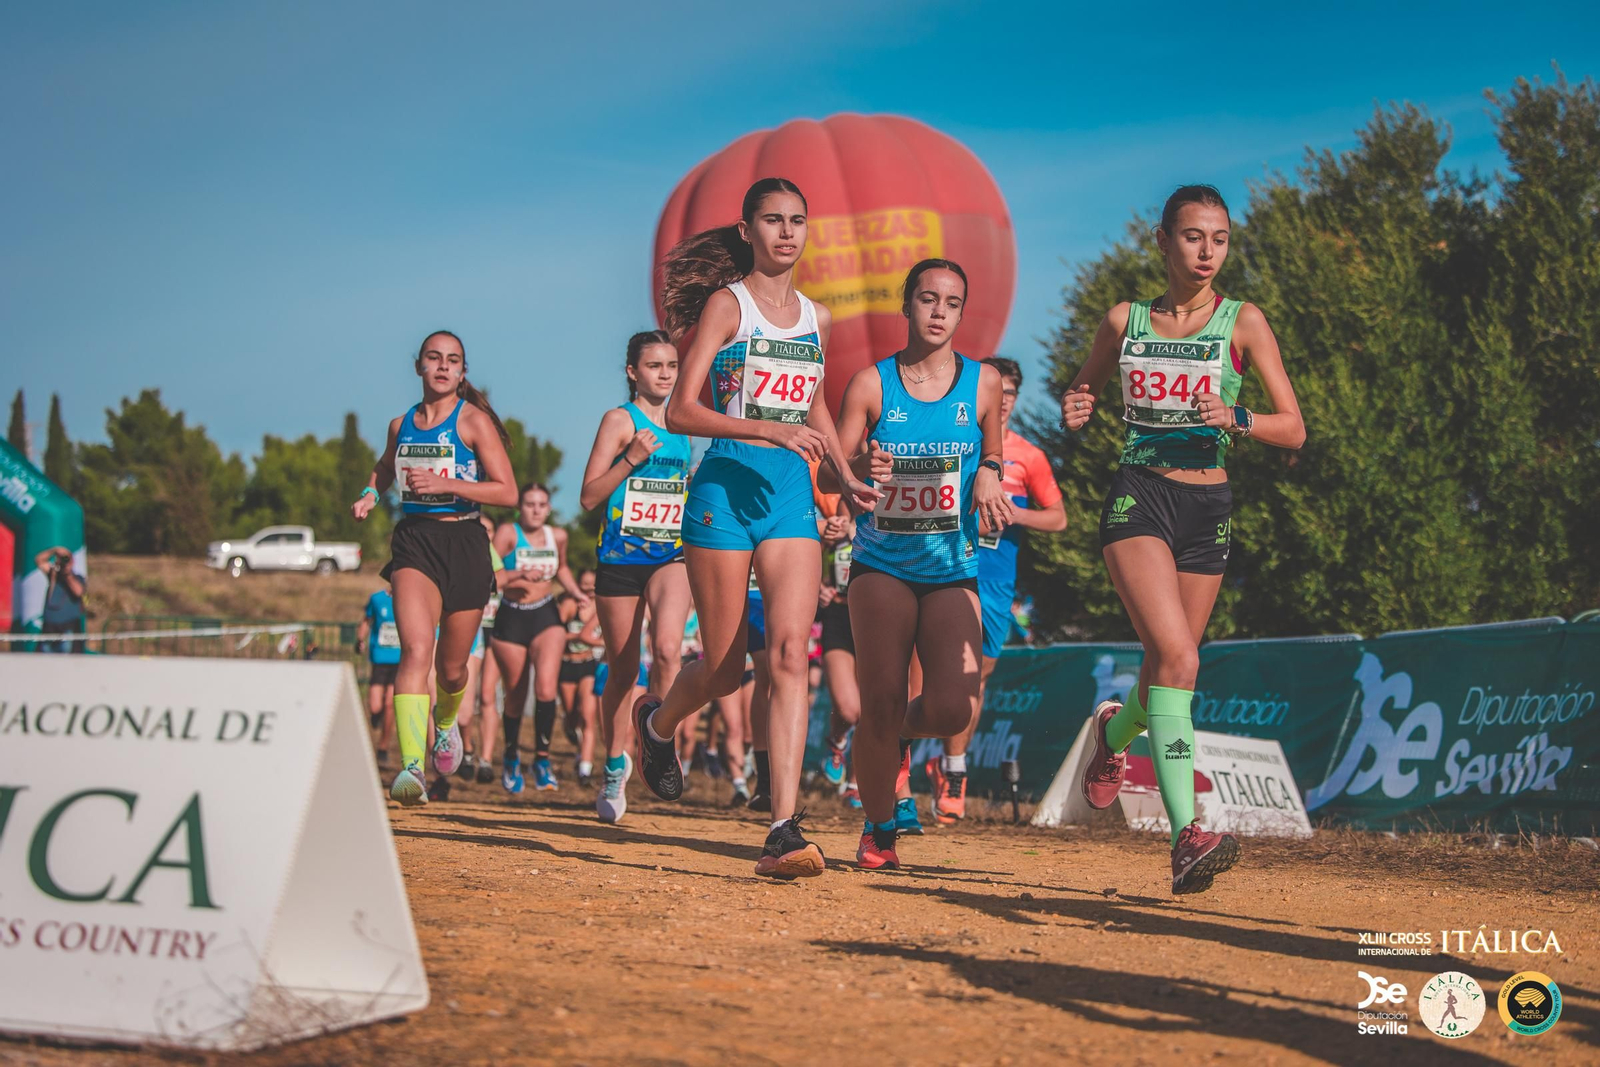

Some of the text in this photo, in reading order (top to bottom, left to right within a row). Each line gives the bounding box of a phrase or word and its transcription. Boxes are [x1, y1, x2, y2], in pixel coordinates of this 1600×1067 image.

[804, 212, 929, 250] UERZAS
[774, 341, 810, 356] ITÁLICA
[1151, 342, 1197, 355] ITÁLICA
[753, 370, 818, 404] 7487
[1129, 369, 1211, 403] 8344
[880, 442, 974, 455] TROTASIERRA
[898, 458, 939, 470] ITÁLICA
[646, 481, 676, 491] ITÁLICA
[882, 484, 955, 512] 7508
[630, 502, 681, 524] 5472
[1458, 682, 1595, 735] Diputación
[216, 710, 278, 745] DE
[1435, 731, 1574, 798] Sevilla
[1212, 763, 1298, 812] ITÁLICA
[34, 919, 217, 961] COUNTRY
